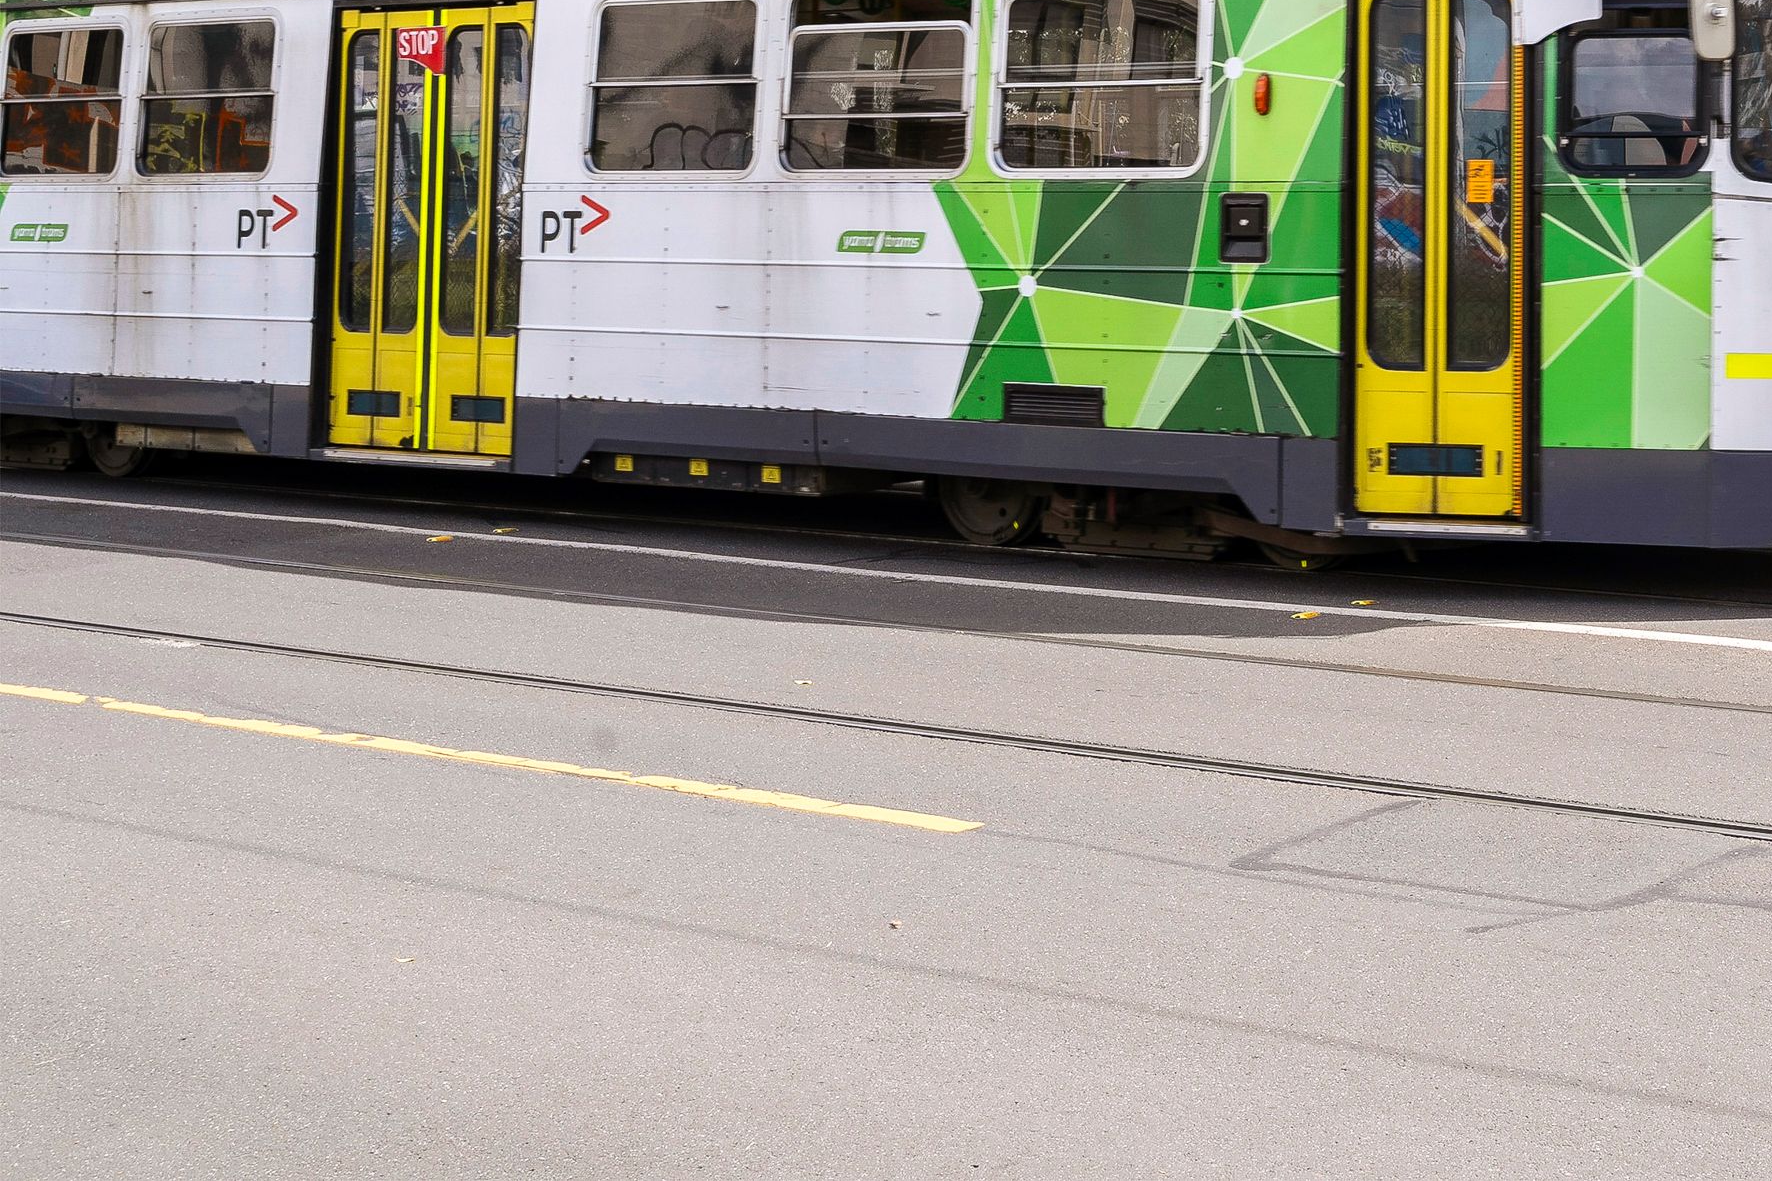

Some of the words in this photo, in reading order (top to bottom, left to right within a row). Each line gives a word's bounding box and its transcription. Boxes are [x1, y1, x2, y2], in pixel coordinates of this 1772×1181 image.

[399, 30, 439, 56] STOP
[237, 209, 274, 249] PT
[541, 210, 582, 253] PT
